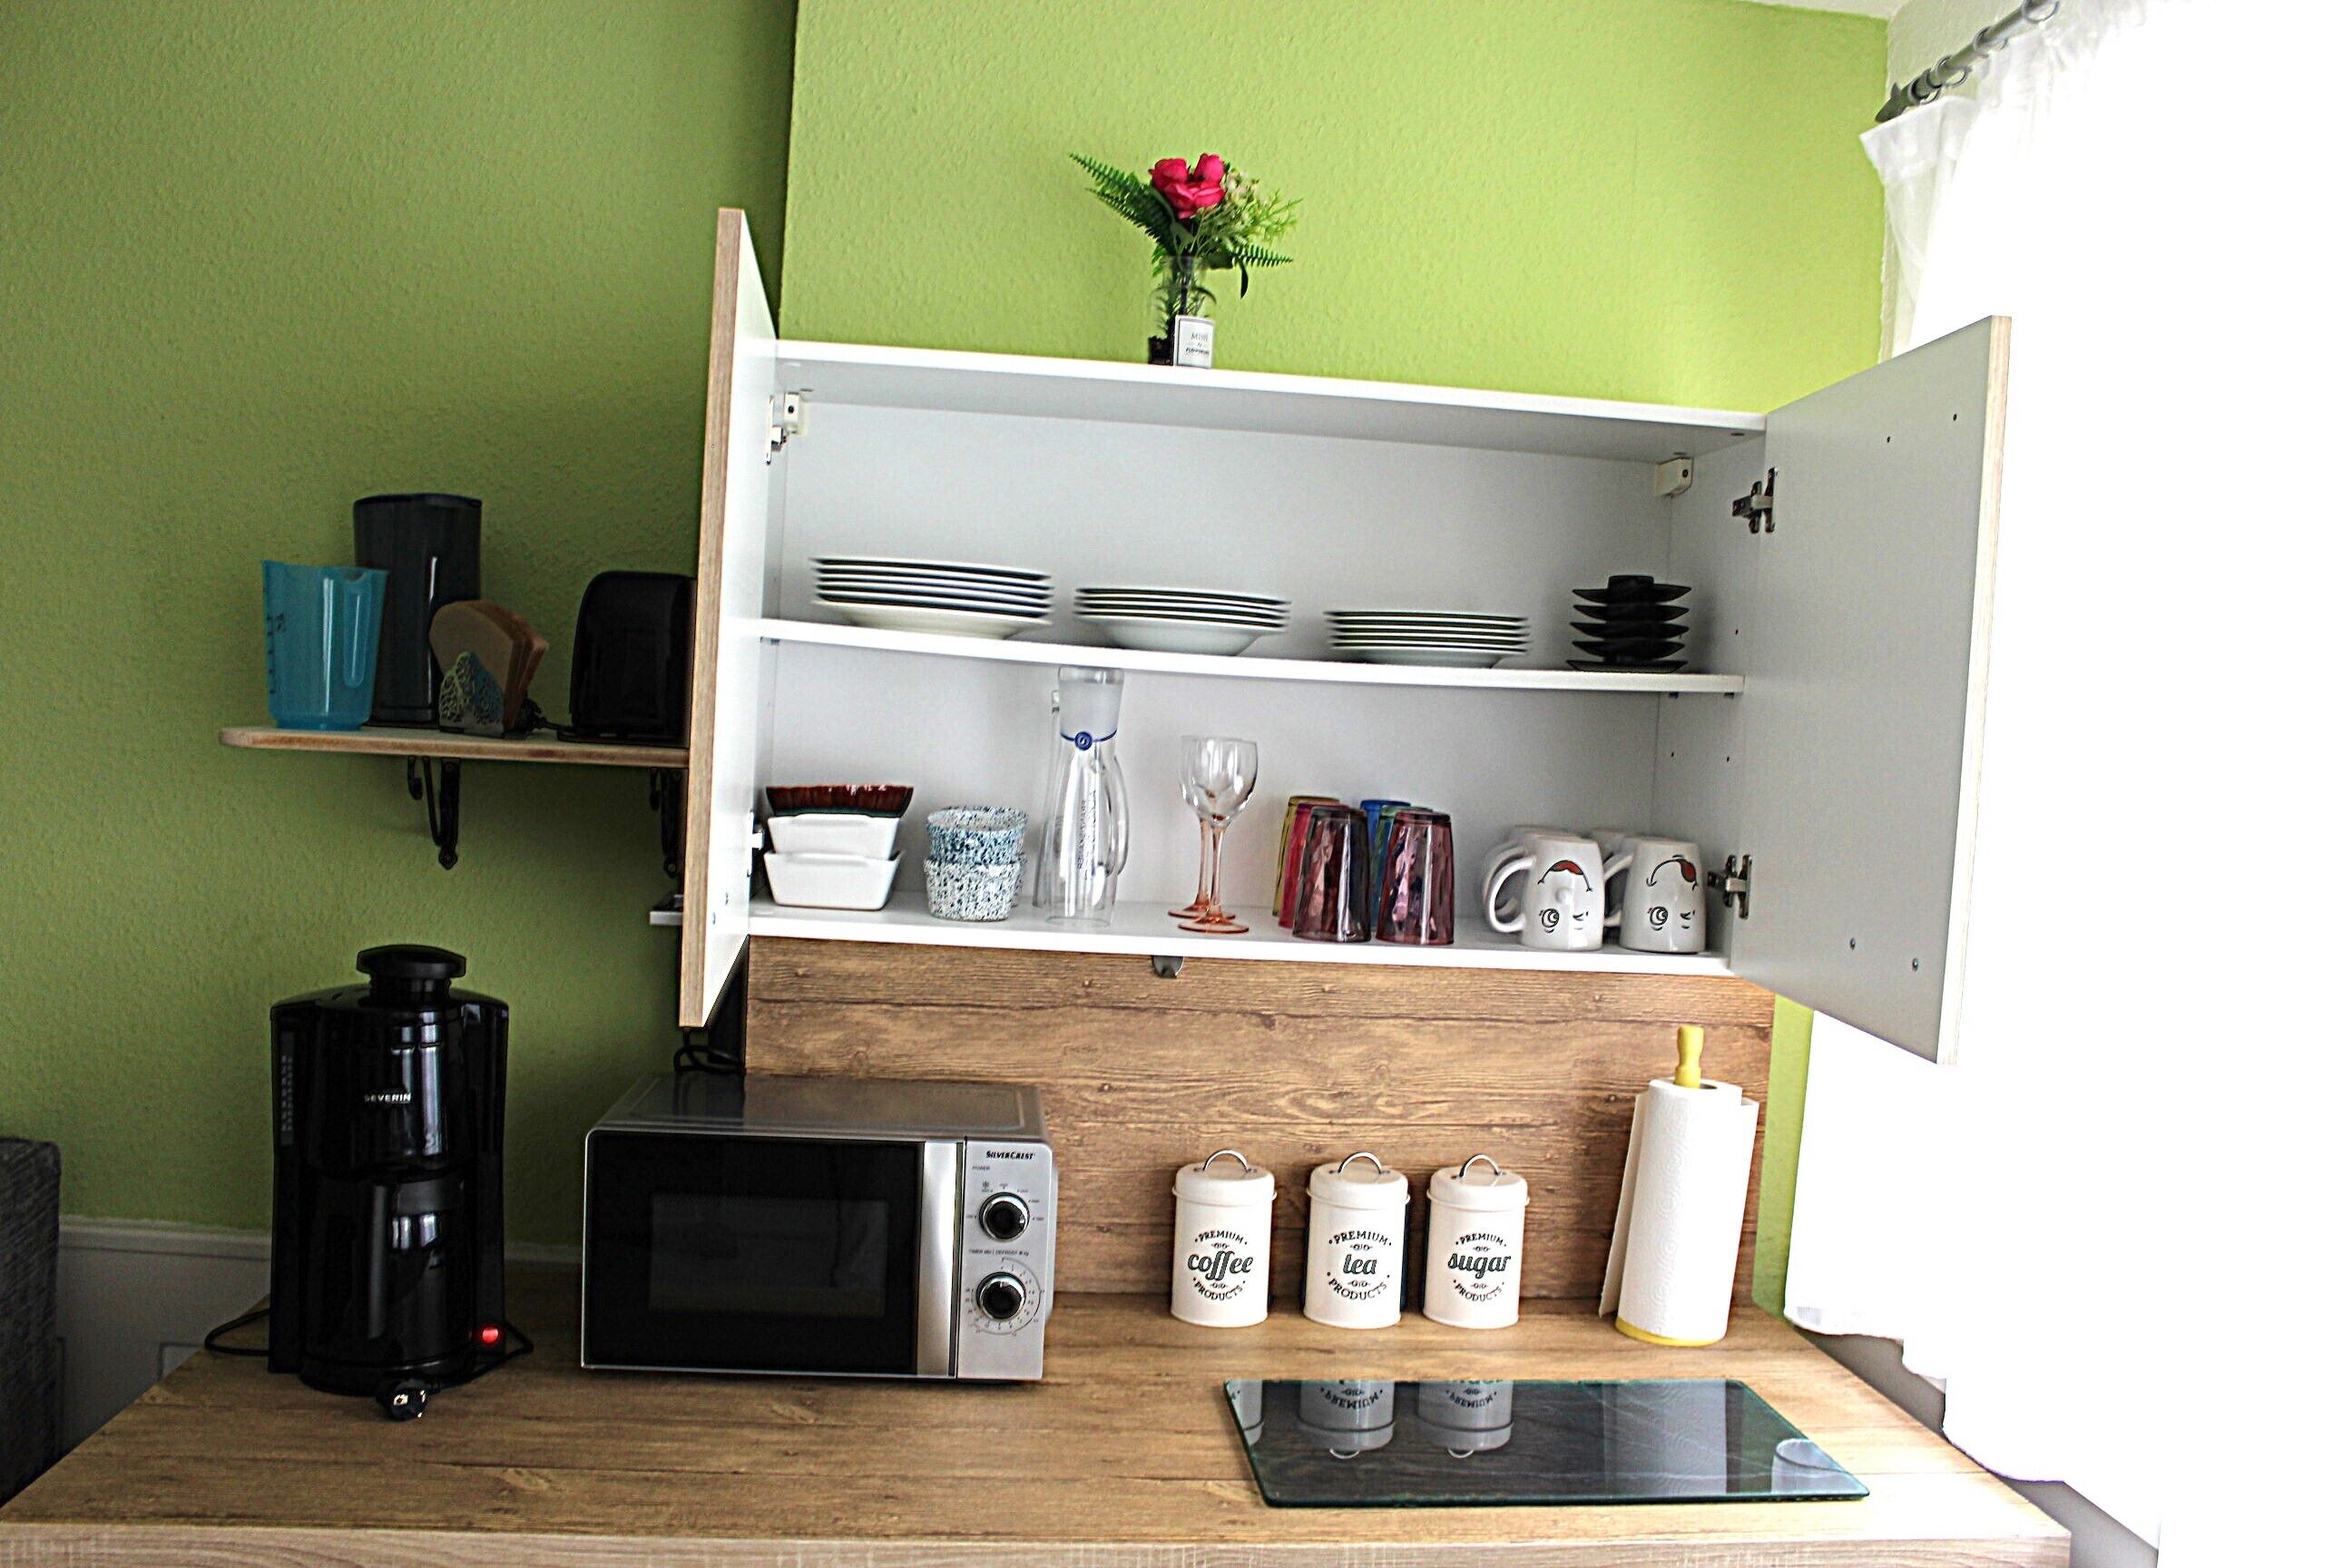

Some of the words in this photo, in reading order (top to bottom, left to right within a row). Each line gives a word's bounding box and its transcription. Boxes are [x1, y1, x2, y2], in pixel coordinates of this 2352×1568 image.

[364, 1093, 412, 1103] SEVERIN
[1198, 1230, 1244, 1245] PREMIUM
[1333, 1230, 1389, 1246] PREMIUM
[1459, 1232, 1504, 1247] PREMIUM
[1187, 1250, 1254, 1281] coffee
[1343, 1252, 1377, 1275] tea
[1447, 1252, 1512, 1279] sugar
[1194, 1279, 1244, 1301] PRODUCTS
[1328, 1278, 1388, 1301] PRODUCTS
[1454, 1280, 1504, 1302] PRODUCTS
